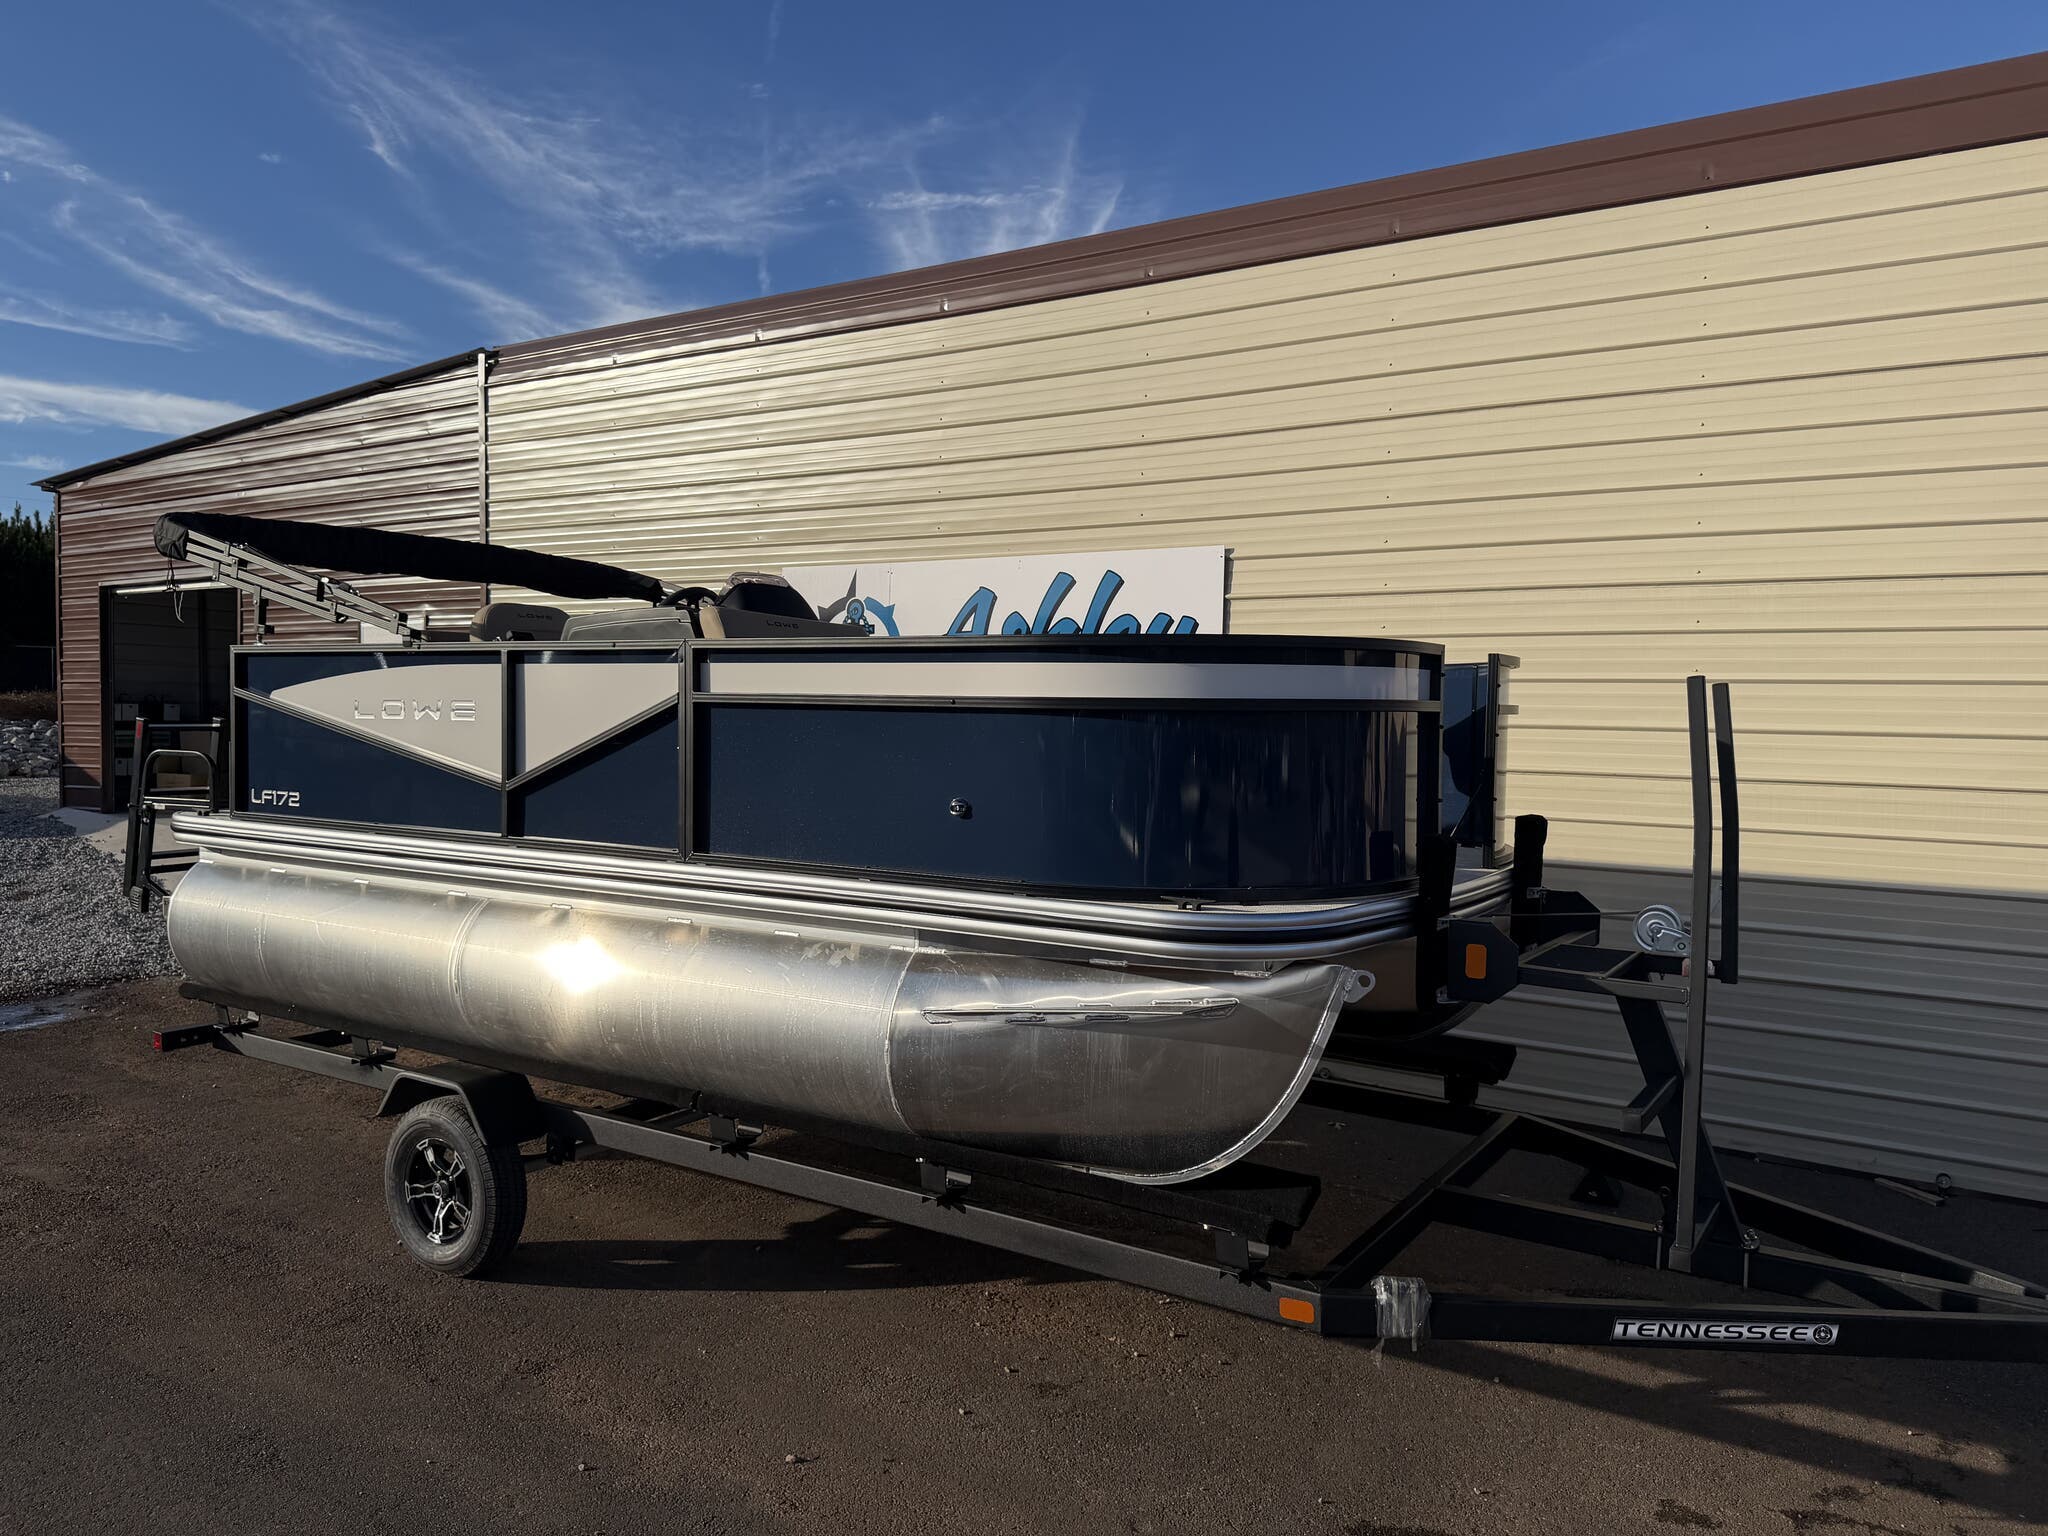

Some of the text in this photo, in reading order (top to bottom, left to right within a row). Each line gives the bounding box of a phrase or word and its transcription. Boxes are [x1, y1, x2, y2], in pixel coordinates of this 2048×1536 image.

[354, 699, 477, 721] LOWE
[251, 788, 300, 807] LF172
[1617, 1322, 1809, 1342] TENNESSEE
